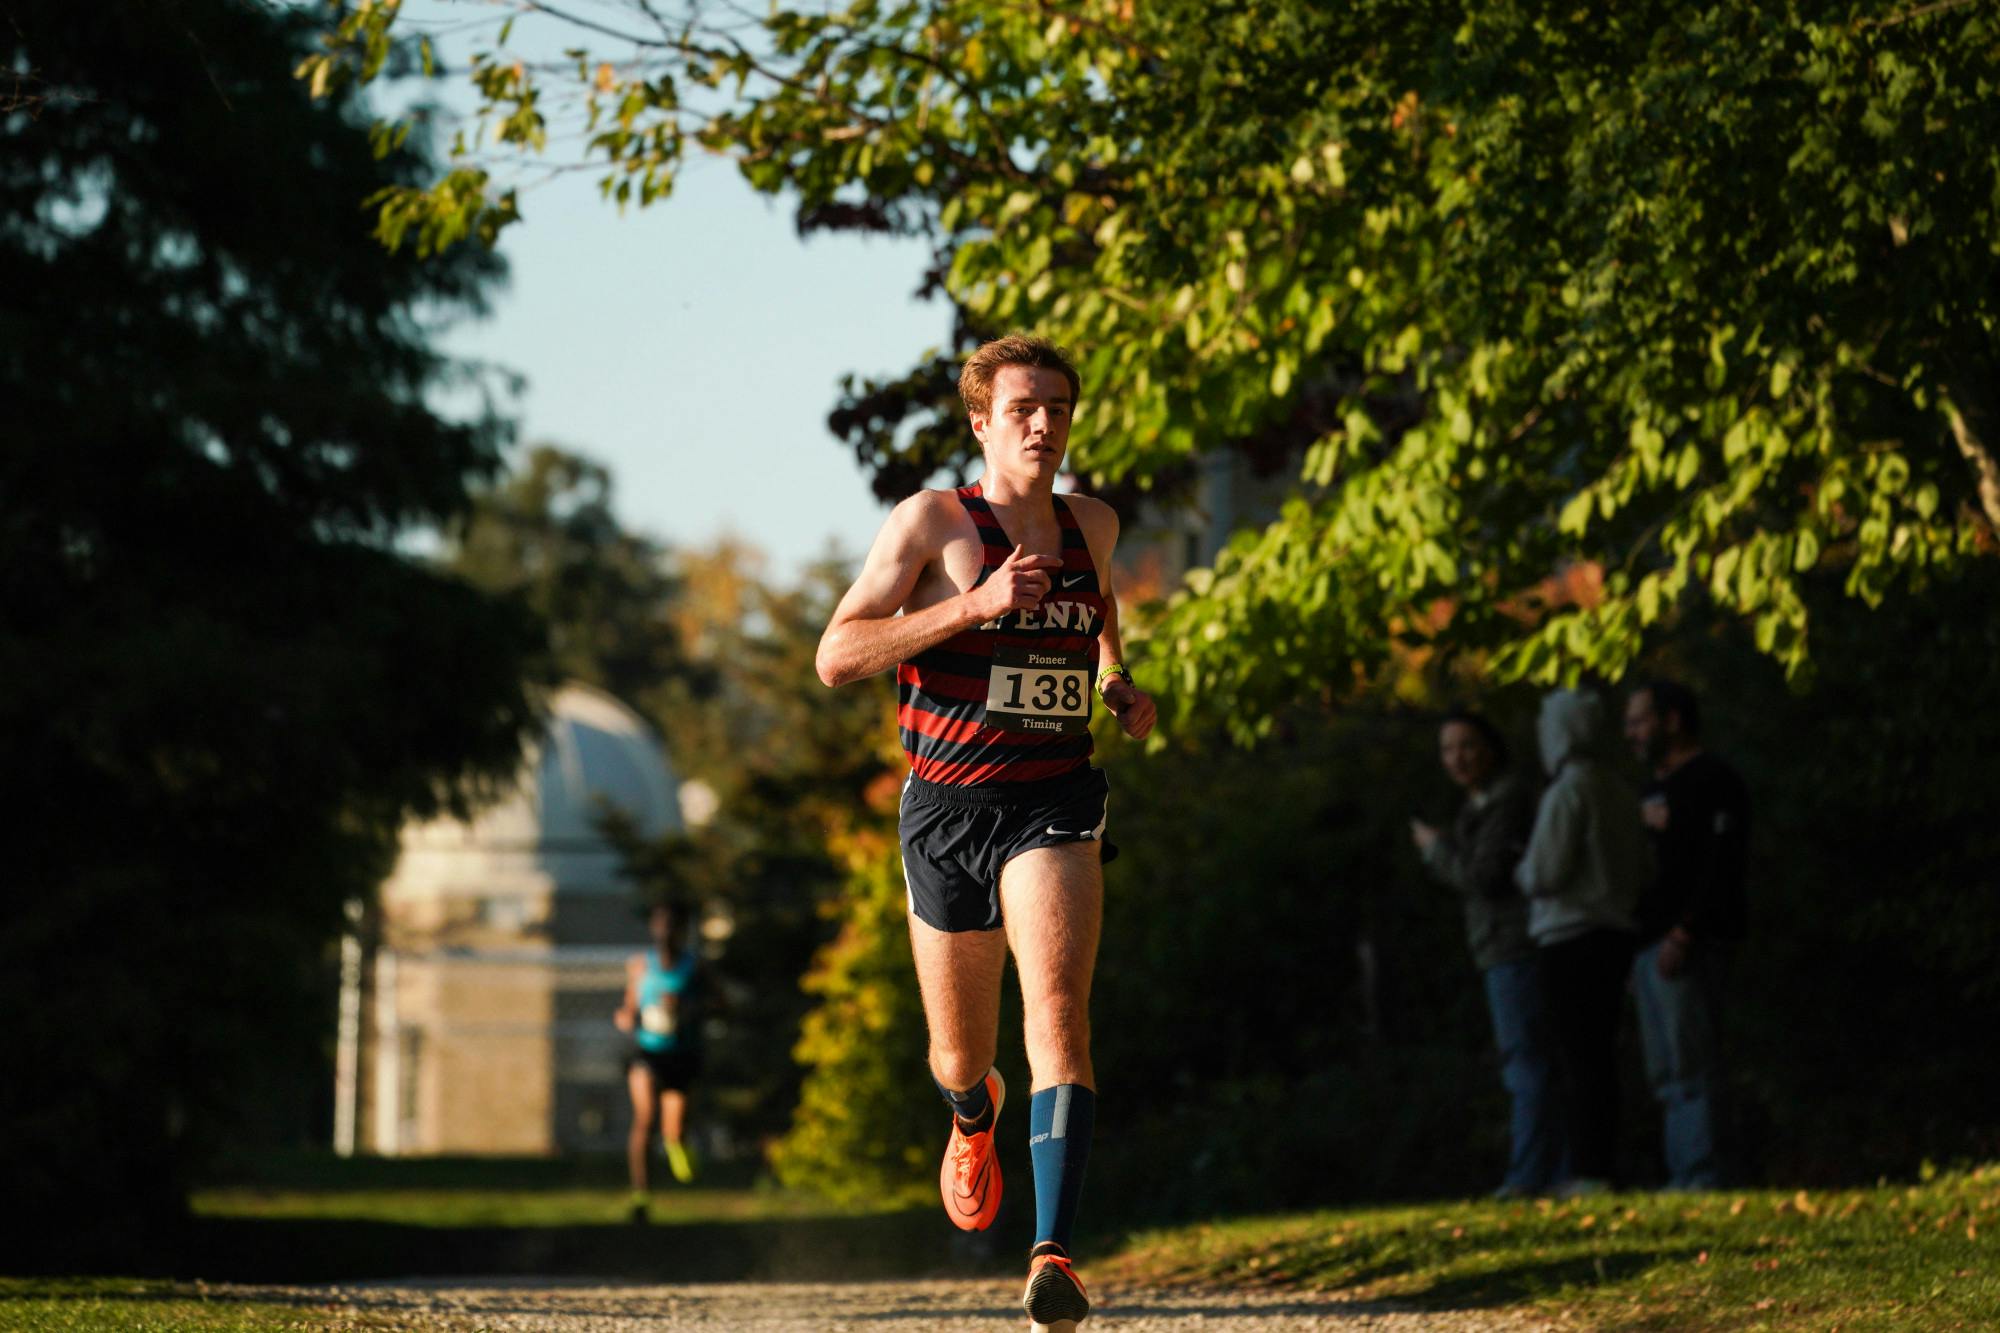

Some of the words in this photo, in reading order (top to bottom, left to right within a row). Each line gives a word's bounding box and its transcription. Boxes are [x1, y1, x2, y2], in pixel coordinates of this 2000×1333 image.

[1028, 654, 1067, 665] Pioneer
[1003, 673, 1082, 711] 138
[1022, 718, 1062, 732] Timing
